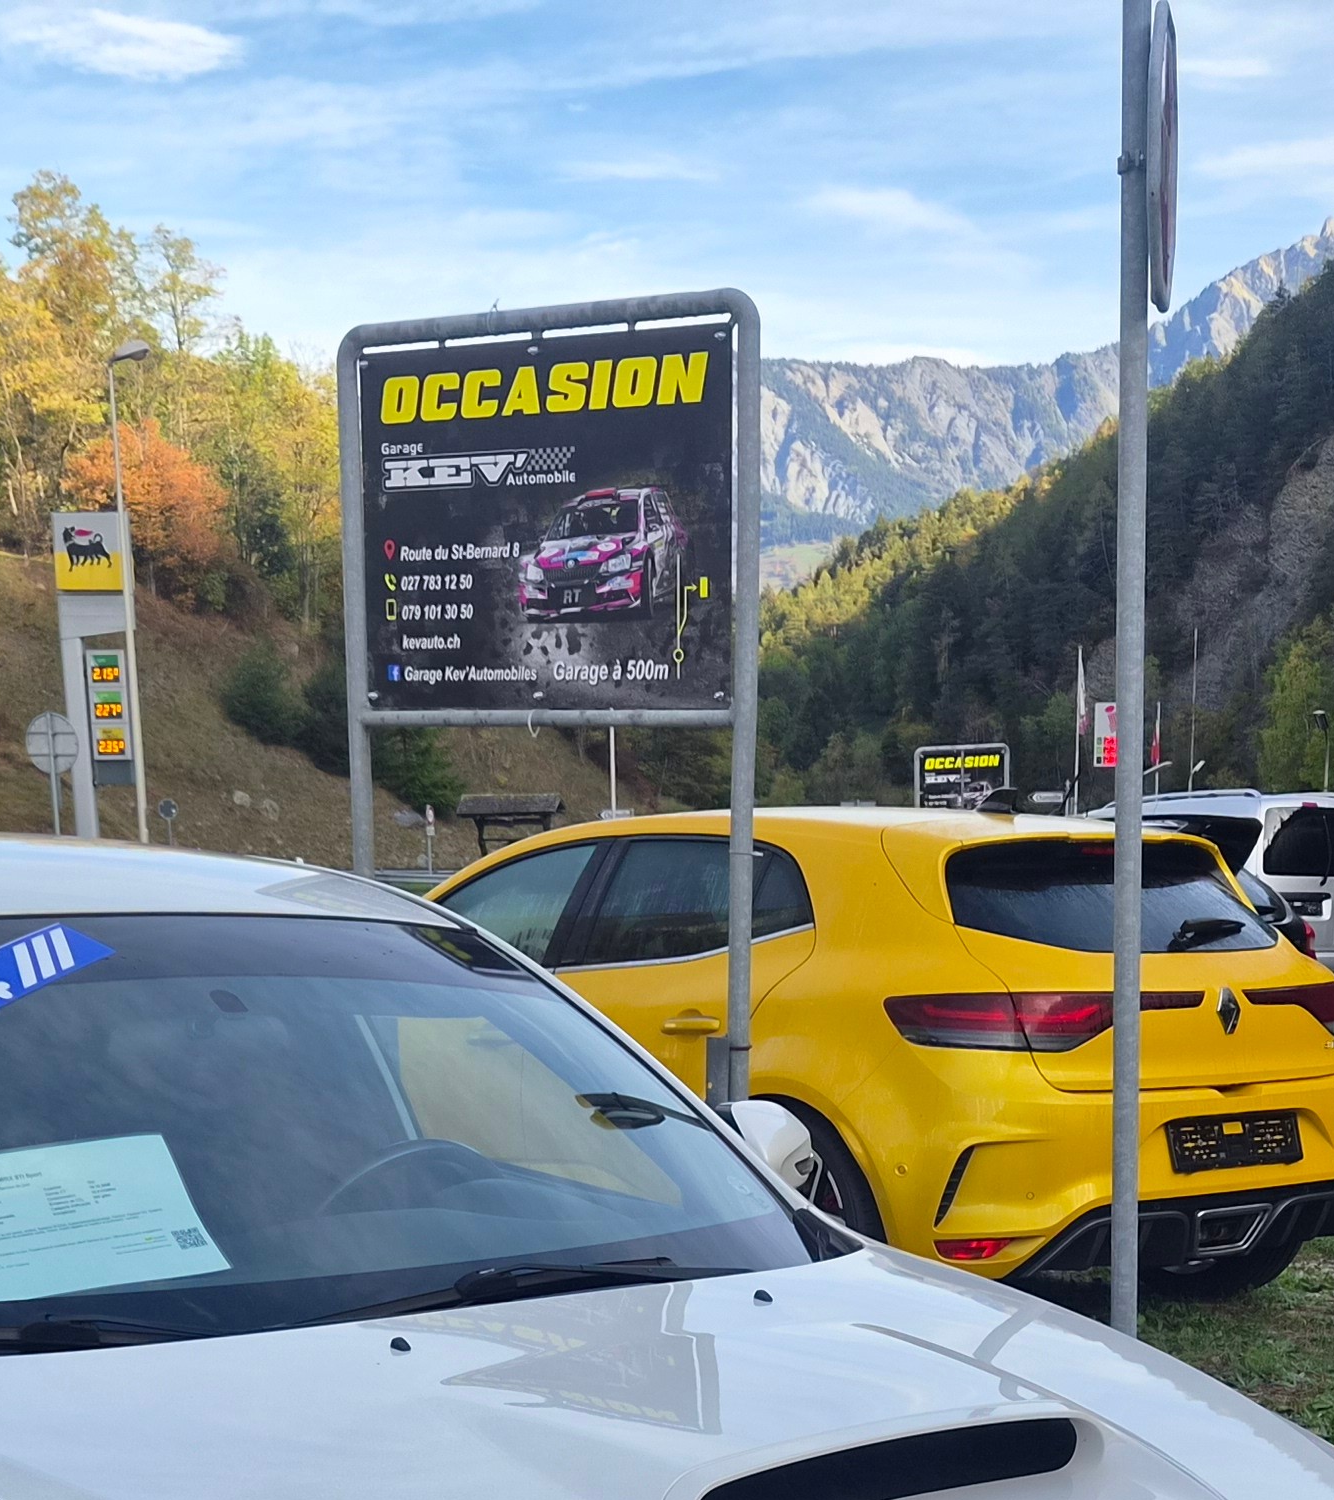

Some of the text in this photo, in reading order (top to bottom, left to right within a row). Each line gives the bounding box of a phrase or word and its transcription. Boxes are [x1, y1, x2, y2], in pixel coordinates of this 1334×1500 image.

[380, 352, 709, 425] OCCASION
[381, 443, 423, 456] Garage
[506, 471, 576, 486] Automobile
[400, 542, 520, 561] Route du St-Bernard 8
[401, 574, 473, 591] 027 783 12 50
[402, 604, 473, 621] 079 101 30 50
[402, 634, 461, 650] kevauto.ch
[404, 665, 537, 685] Garage Kev'Automobiles
[553, 659, 669, 686] Garage à 500m
[924, 754, 1000, 771] OCCASION
